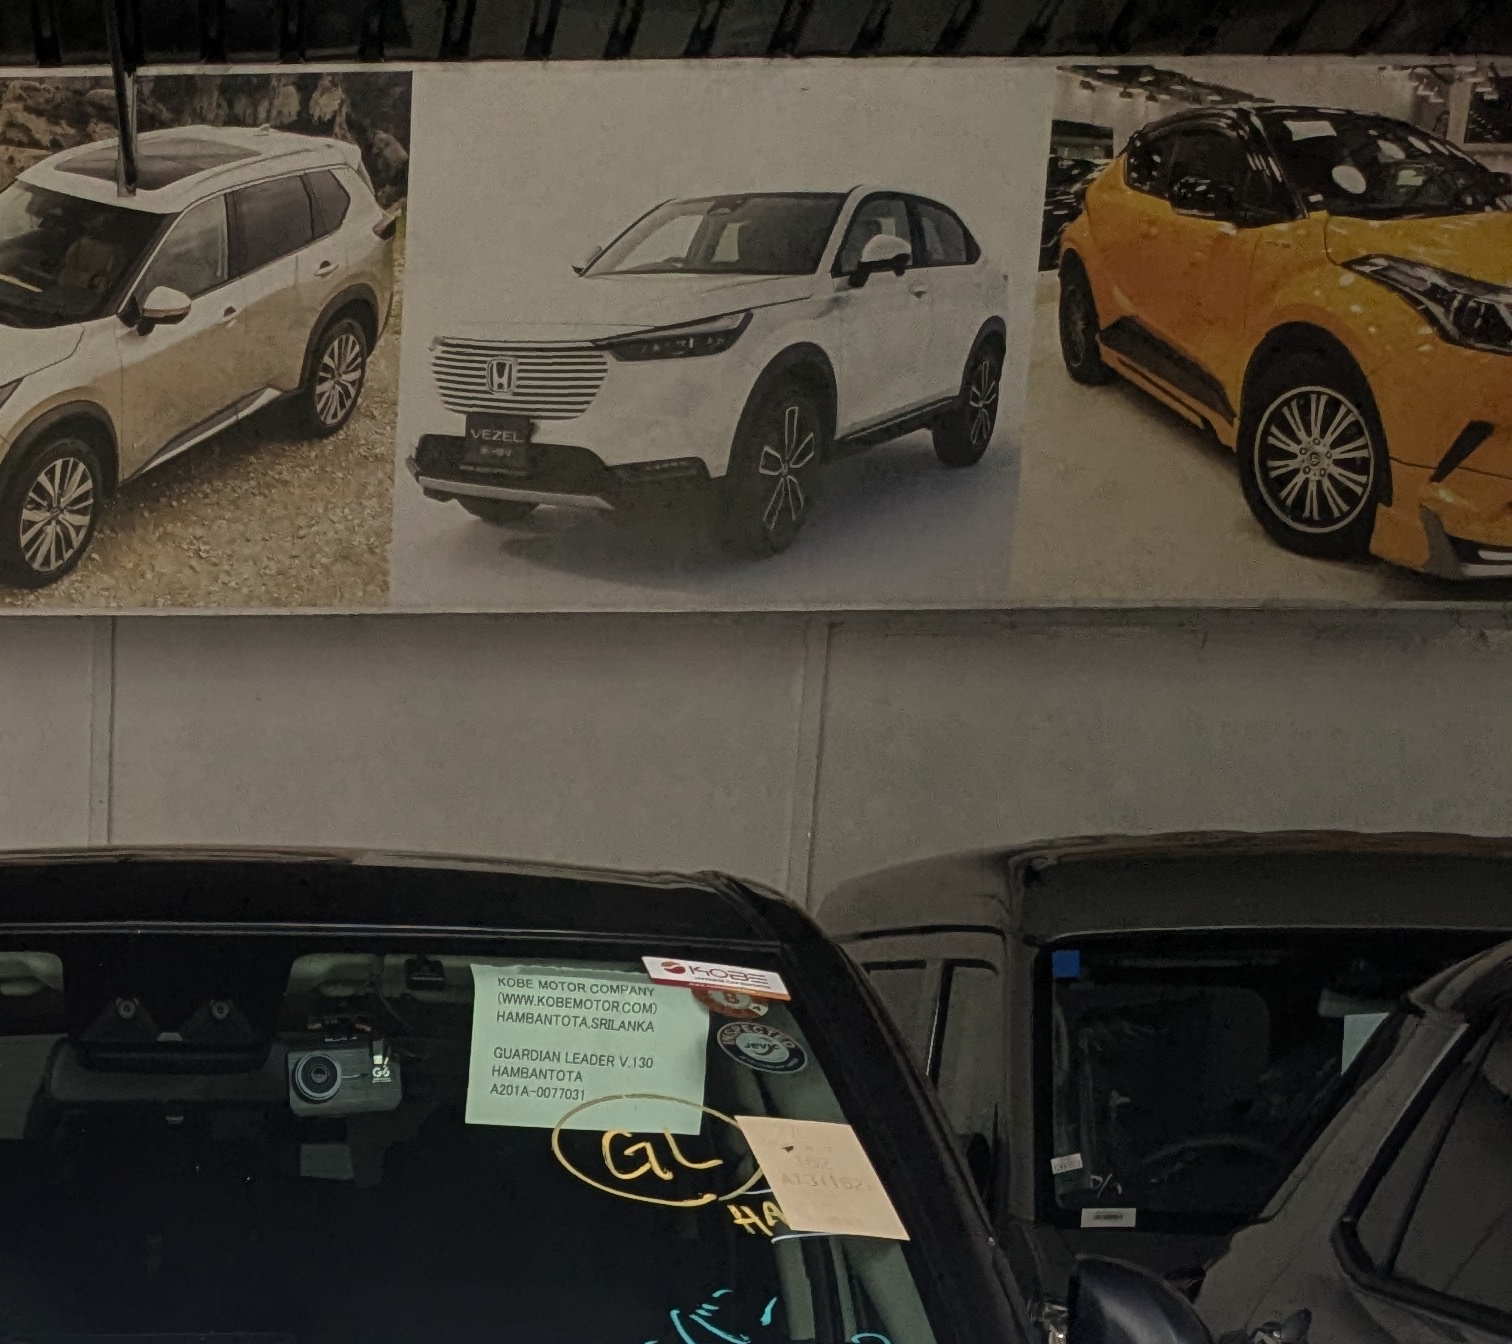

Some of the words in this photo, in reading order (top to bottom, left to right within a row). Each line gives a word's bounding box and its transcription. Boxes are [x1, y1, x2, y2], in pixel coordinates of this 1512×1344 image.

[470, 428, 526, 443] VEZEL
[688, 964, 769, 986] KOBE
[498, 977, 534, 989] KOBE
[538, 979, 586, 994] MOTOR
[590, 984, 655, 998] COMPANY
[498, 991, 658, 1015] (WWW.KOBEMOTOR.COM)
[493, 1047, 561, 1063] GUARDIAN
[565, 1049, 615, 1068] LEADER
[620, 1056, 654, 1069] V.130
[492, 1065, 583, 1082] HAMBANTOTA
[490, 1083, 585, 1101] A201A-0077031
